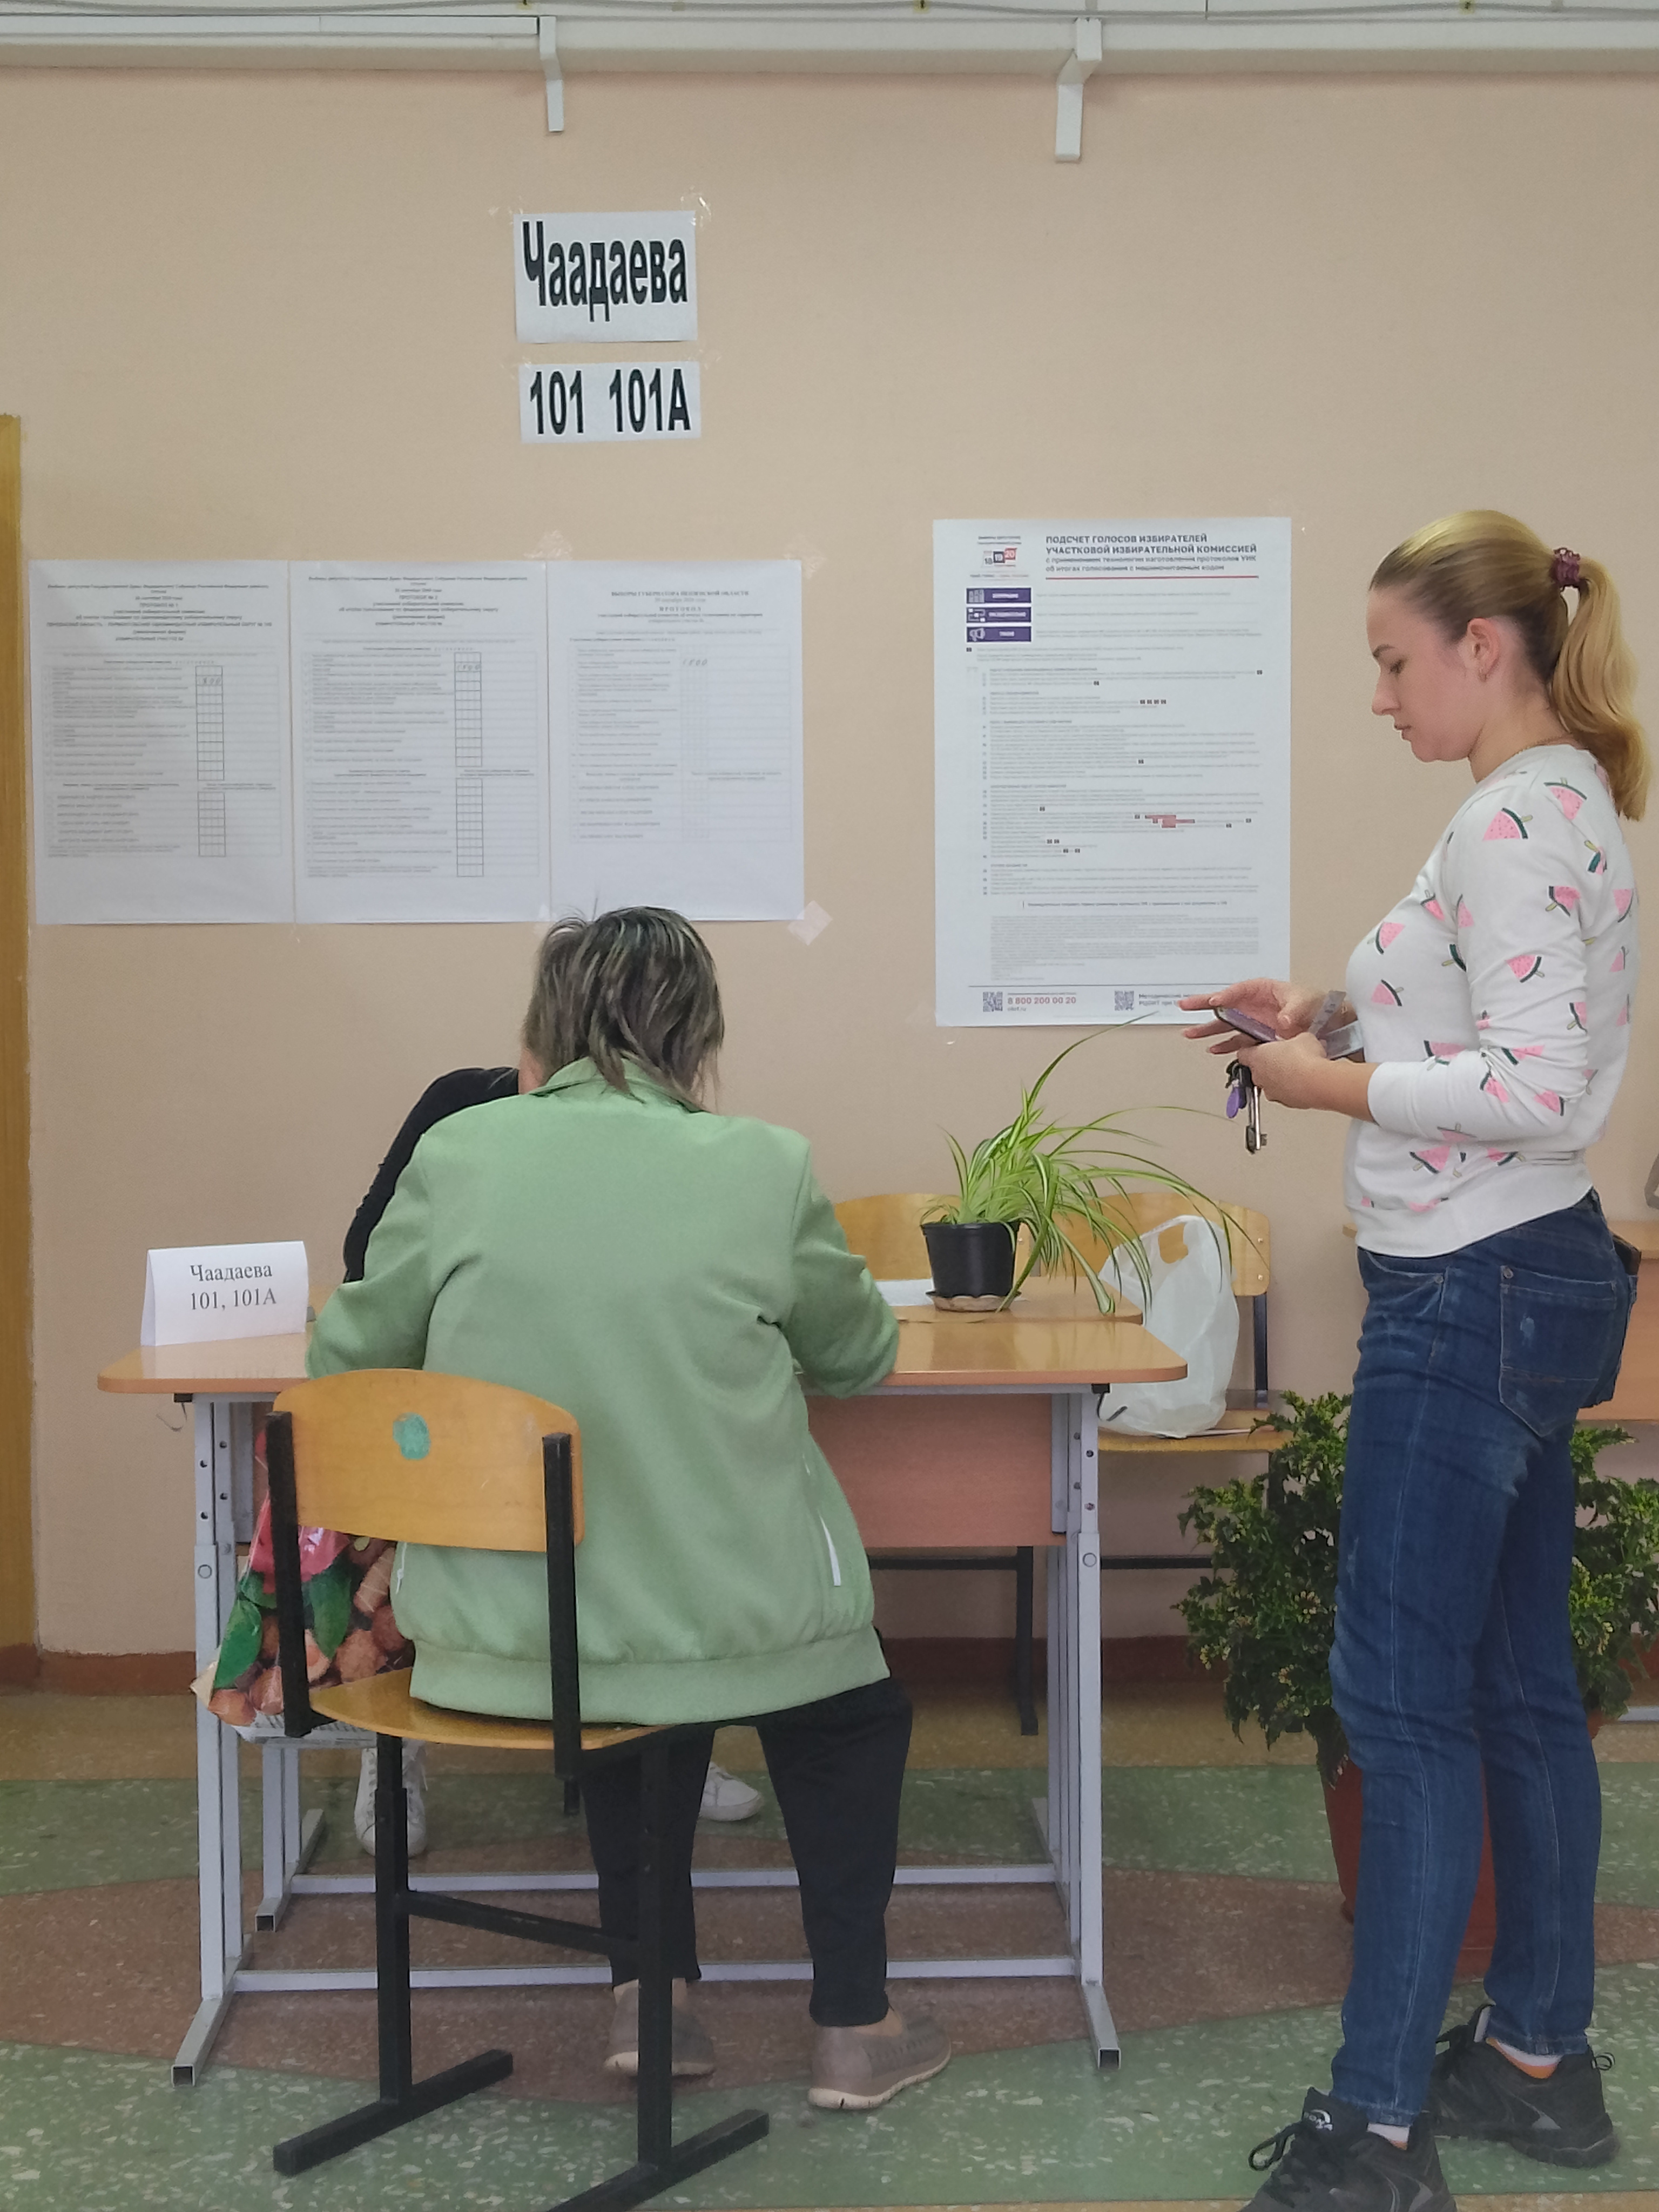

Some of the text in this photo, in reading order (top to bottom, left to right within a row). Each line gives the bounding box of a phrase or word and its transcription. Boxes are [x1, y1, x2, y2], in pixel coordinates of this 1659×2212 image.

[522, 220, 688, 322] Чаадаева
[529, 370, 584, 435] 101
[1046, 533, 1208, 544] ПОДСЧЕТ ГОЛОСОВ ИЗБИРАТЕЛЕЙ
[1046, 543, 1257, 555] УЧАСТКОВОЙ ИЗБИРАТЕЛЬНОЙ КОМИССИЕЙ
[190, 1265, 272, 1282] Чаадаева
[191, 1291, 225, 1311] 101,
